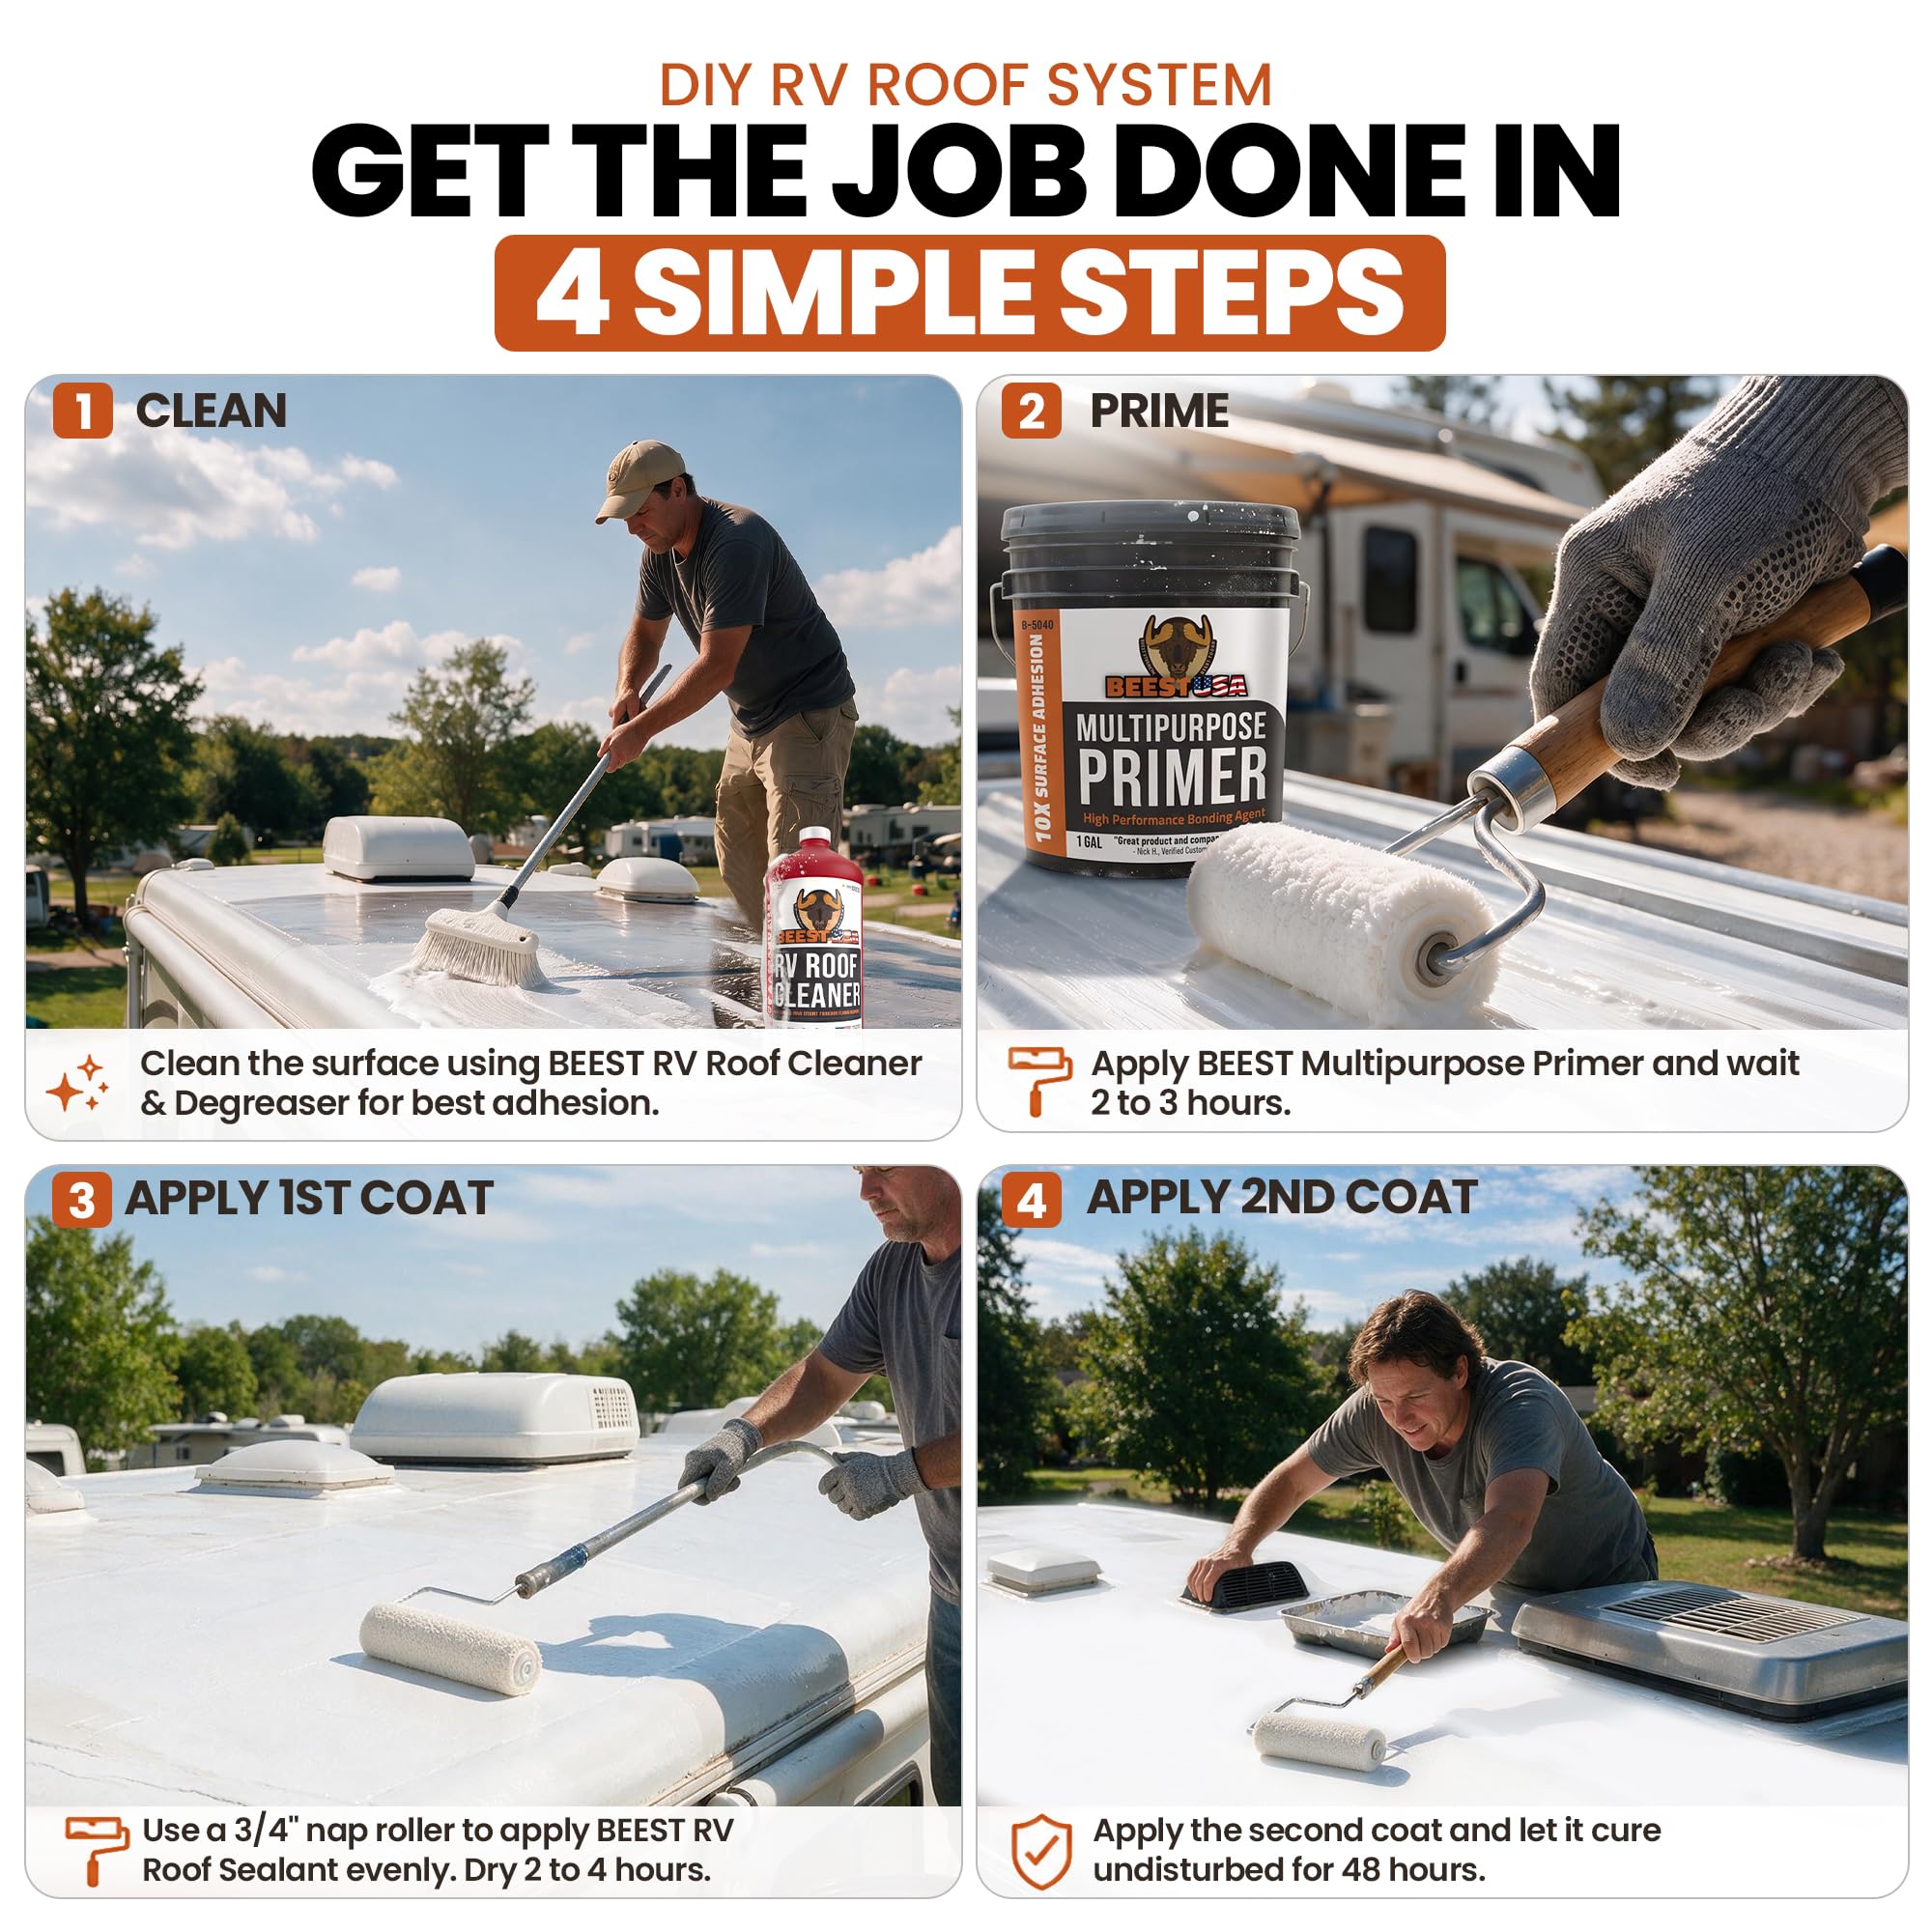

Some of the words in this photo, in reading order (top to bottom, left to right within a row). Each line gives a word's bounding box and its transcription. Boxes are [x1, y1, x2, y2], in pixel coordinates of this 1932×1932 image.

[1021, 620, 1054, 630] B-5040
[1030, 634, 1045, 720] ADHESION
[1077, 711, 1266, 742] MULTIPURPOSE
[1033, 724, 1048, 798] SURFACE
[1079, 746, 1266, 807] PRIMER
[1034, 802, 1051, 842] 10X
[1083, 812, 1109, 828] High
[1113, 813, 1184, 826] Performance
[1187, 812, 1233, 825] Bonding
[1235, 808, 1266, 824] Agent
[1076, 836, 1081, 847] 1
[1084, 836, 1102, 849] GAL
[1137, 847, 1151, 856] Nick
[1161, 846, 1184, 856] Verified
[1141, 837, 1172, 847] product
[1174, 836, 1188, 844] and
[775, 953, 798, 978] RV
[806, 952, 858, 978] ROOF
[775, 982, 860, 1008] CLEANER
